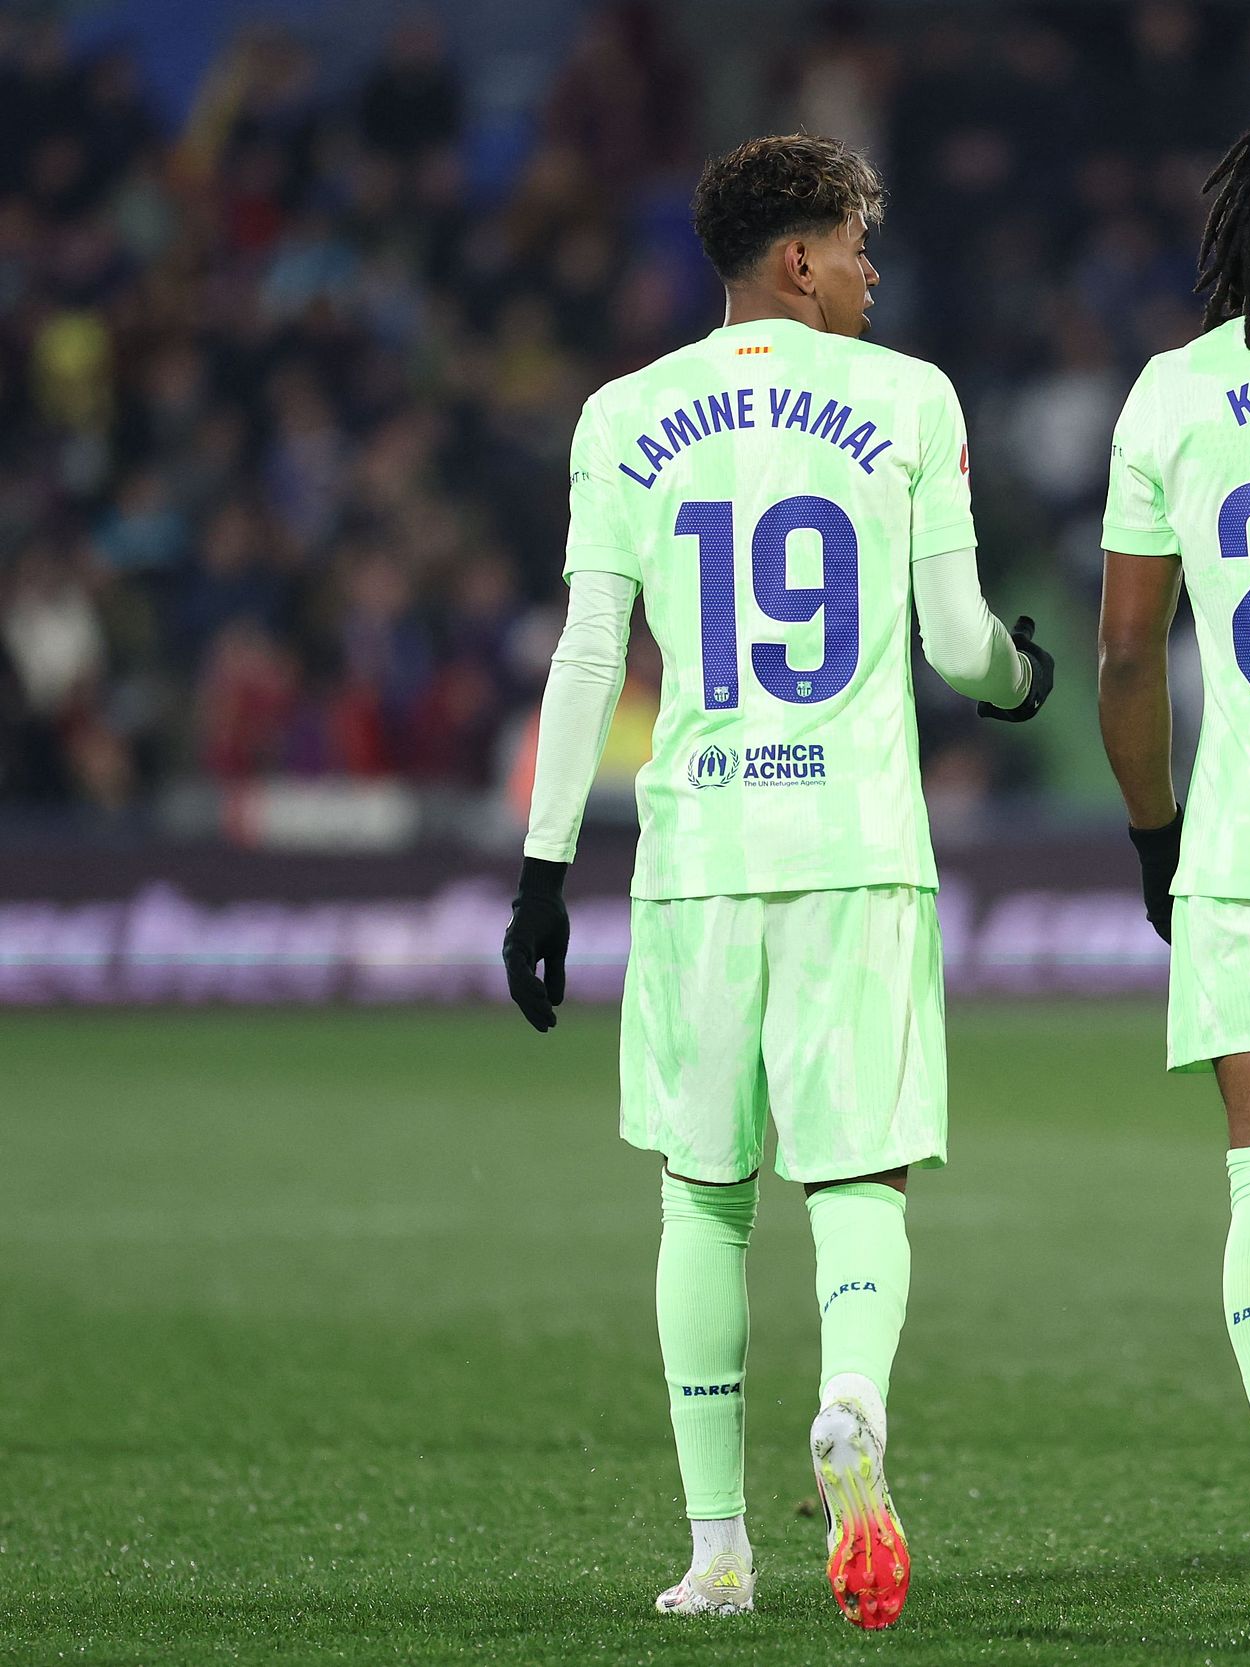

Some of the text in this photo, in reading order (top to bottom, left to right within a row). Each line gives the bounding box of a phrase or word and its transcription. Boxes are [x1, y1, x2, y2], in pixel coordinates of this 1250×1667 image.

[618, 388, 893, 490] LAMINE YAMAL
[674, 495, 859, 711] 19
[745, 744, 825, 761] UNHCR
[743, 762, 826, 779] ACNUR
[770, 780, 799, 788] Refugee
[800, 779, 826, 787] Agency
